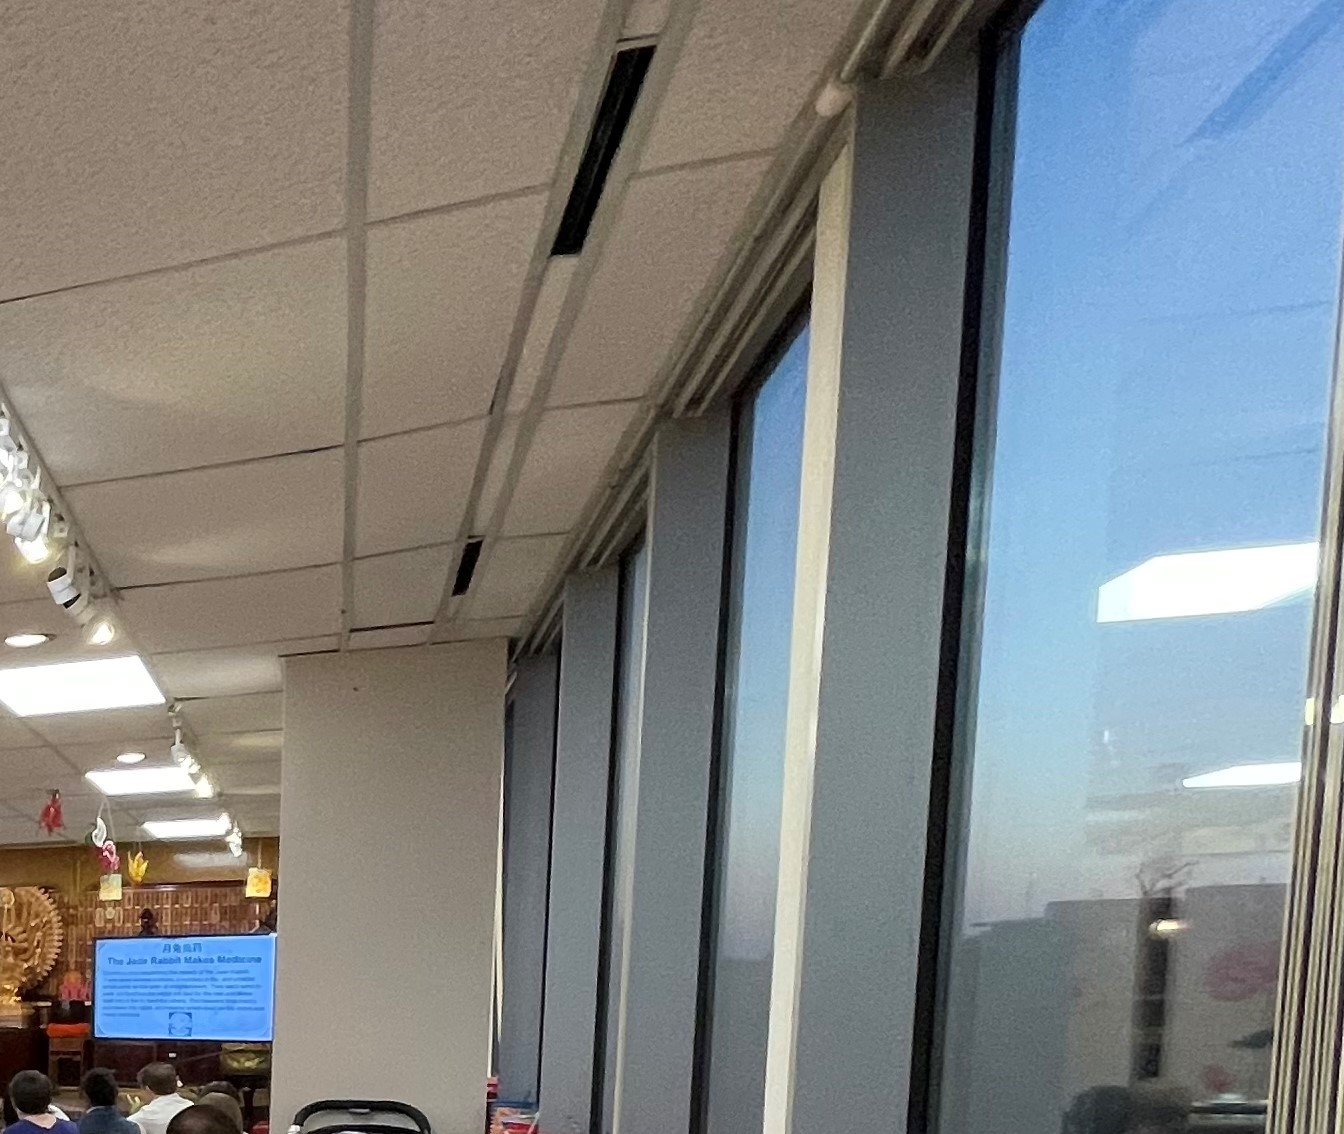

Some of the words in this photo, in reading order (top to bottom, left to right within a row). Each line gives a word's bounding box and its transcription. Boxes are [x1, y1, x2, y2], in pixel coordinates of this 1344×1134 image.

[107, 956, 124, 966] The
[150, 956, 181, 965] Rabbit
[184, 955, 215, 965] Makes
